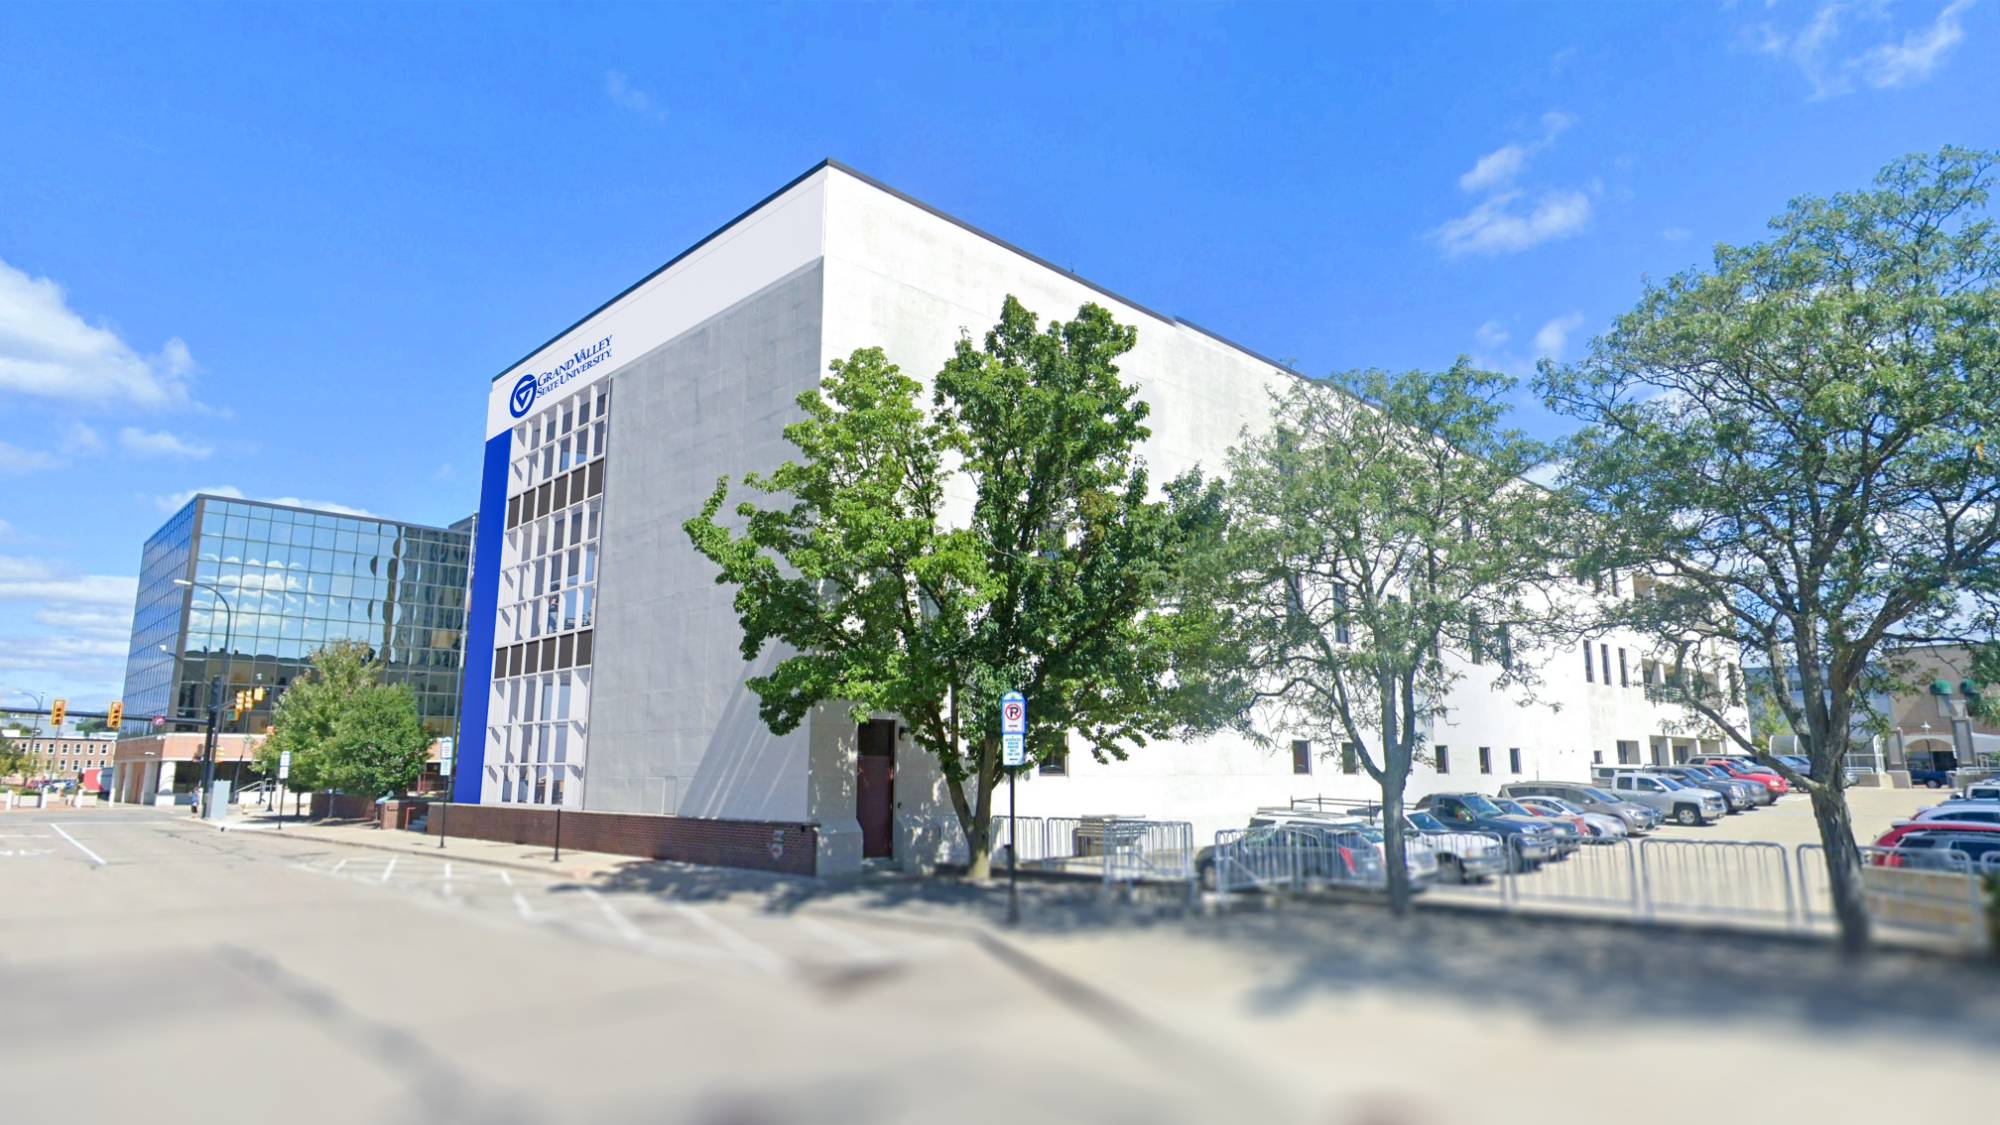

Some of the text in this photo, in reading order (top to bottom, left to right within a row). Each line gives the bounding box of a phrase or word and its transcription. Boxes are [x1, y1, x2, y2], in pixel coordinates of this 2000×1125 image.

[537, 349, 612, 398] STATE UNIVERSITY
[538, 335, 613, 386] GRAND VALLEY
